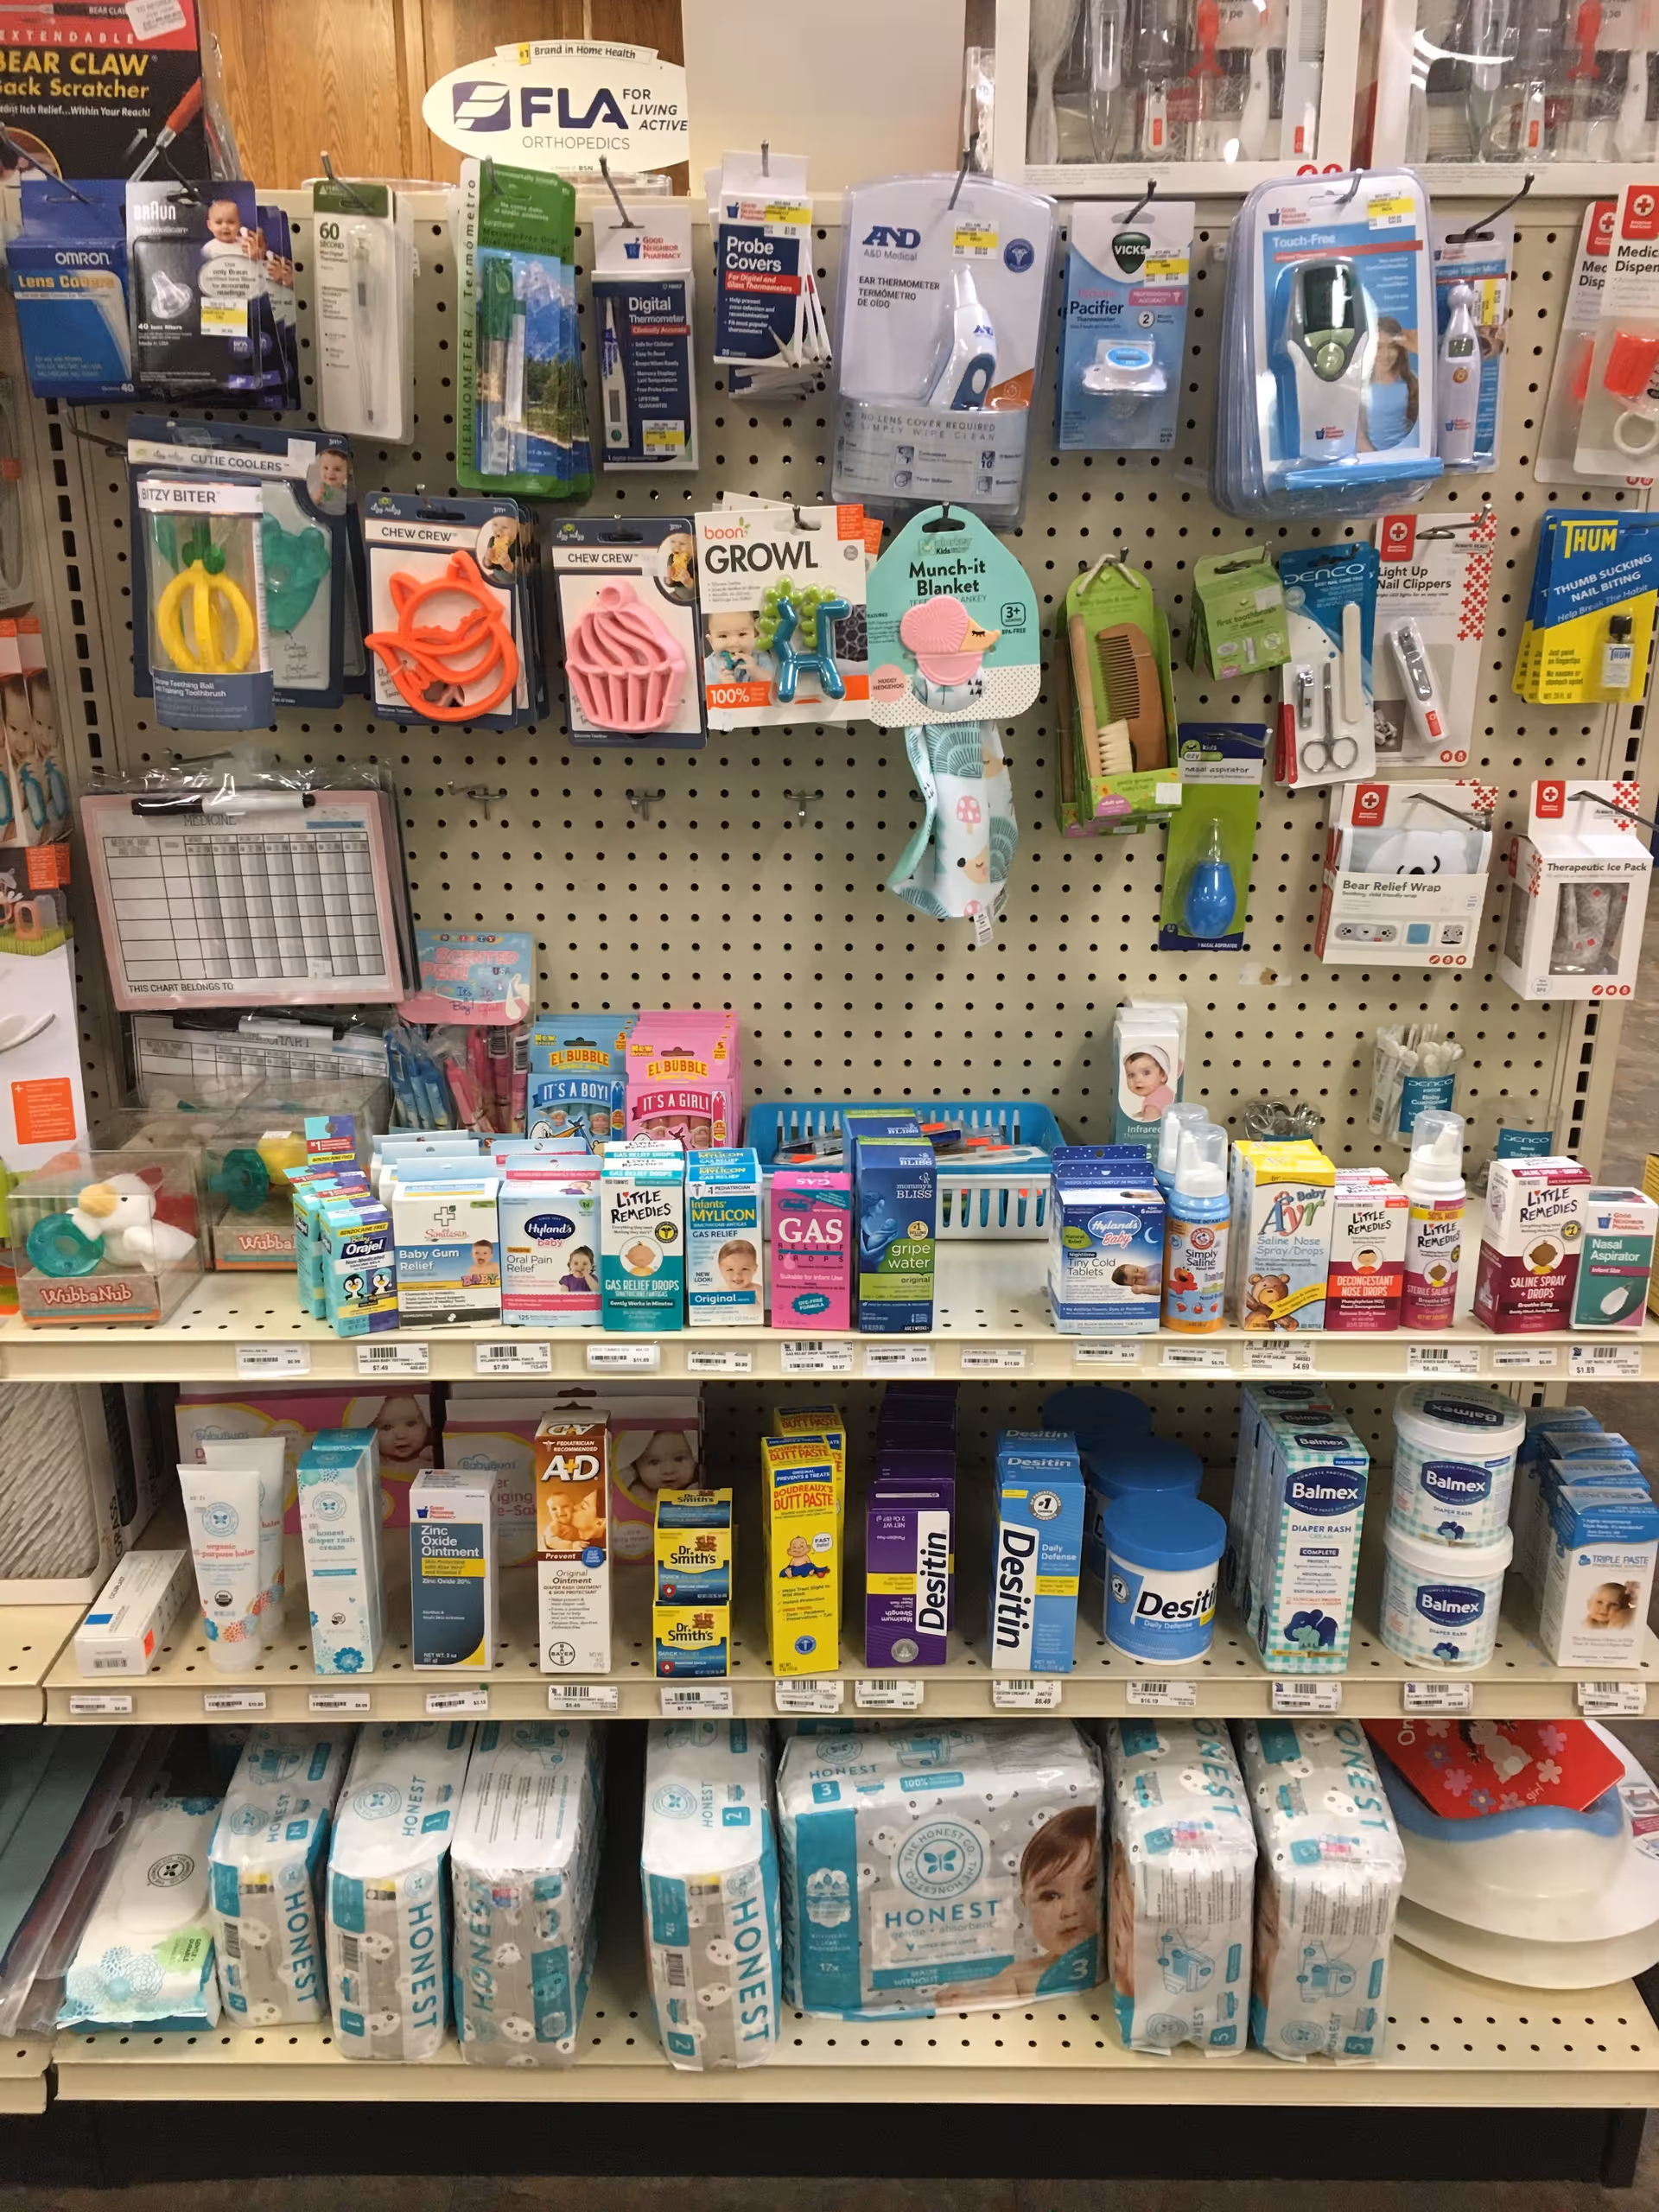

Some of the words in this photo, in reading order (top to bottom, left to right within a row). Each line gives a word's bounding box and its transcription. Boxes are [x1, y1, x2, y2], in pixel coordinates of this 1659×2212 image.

[534, 46, 562, 56] Brand
[575, 46, 602, 55] Home
[605, 48, 636, 59] Health
[70, 53, 149, 76] CLAW
[0, 76, 41, 96] ack
[50, 78, 149, 99] Scratcher
[623, 89, 651, 100] FOR
[521, 87, 629, 129] FLA
[632, 104, 677, 116] LIVING
[639, 120, 688, 131] ACTIVE
[523, 136, 630, 149] ORTHOPEDICS
[320, 223, 340, 239] 60
[727, 236, 773, 254] Probe
[1273, 234, 1336, 248] Touch-Free
[1115, 245, 1147, 255] VICKS
[55, 252, 110, 265] OMRON
[726, 253, 781, 272] Covers
[18, 276, 54, 288] Lens
[60, 276, 115, 289] Covers
[878, 277, 940, 289] THERMOMETER
[629, 297, 671, 314] Digital
[1070, 301, 1123, 315] Pacifier
[190, 454, 222, 466] CUTIE
[226, 457, 283, 472] COOLERS
[142, 489, 170, 502] BITZY
[174, 490, 216, 504] BITER
[382, 526, 415, 537] CHEW
[418, 529, 453, 541] CREW
[705, 526, 744, 539] boon
[1560, 520, 1618, 558] THUM
[568, 553, 599, 563] CHEW
[602, 553, 633, 563] CREW
[705, 541, 818, 574] GROWL
[909, 558, 986, 578] Munch-it
[1378, 567, 1407, 578] Light
[1411, 567, 1427, 578] Up
[1554, 575, 1598, 595] THUMB
[1599, 554, 1653, 579] SUCKING
[918, 578, 979, 596] Blanket
[1377, 580, 1400, 590] Nail
[1403, 579, 1452, 591] Clippers
[1571, 587, 1599, 602] NAIL
[1601, 571, 1642, 592] BITING
[711, 689, 749, 704] 100%
[1548, 863, 1605, 874] Therapeutic
[1607, 863, 1621, 872] Ice
[1624, 863, 1647, 872] Pack
[1343, 880, 1370, 892] Bear
[1374, 882, 1408, 892] Relief
[1411, 883, 1441, 893] Wrap
[129, 984, 148, 993] THIS
[151, 983, 178, 992] CHART
[181, 982, 220, 992] BELONGS
[550, 1054, 563, 1065] EL
[568, 1050, 609, 1066] BUBBLE
[648, 1065, 660, 1076] EL
[664, 1059, 708, 1077] BUBBLE
[896, 1189, 932, 1199] BLISS
[611, 1203, 672, 1224] REMEDIES
[692, 1210, 755, 1222] MYLICON
[1520, 1200, 1578, 1222] REMEDIES
[527, 1223, 572, 1236] Hyland's
[779, 1217, 843, 1243] GAS
[1092, 1217, 1138, 1233] Hyland's
[537, 1238, 563, 1248] baby
[1103, 1232, 1132, 1248] Baby
[1257, 1236, 1288, 1245] Saline
[1592, 1239, 1623, 1249] Nasal
[346, 1240, 383, 1255] Orajel
[892, 1244, 931, 1255] gripe
[1185, 1249, 1217, 1259] Simply
[1256, 1246, 1324, 1256] Spray/Drops
[399, 1250, 428, 1262] Baby
[433, 1249, 460, 1258] Gum
[507, 1255, 528, 1264] Oral
[531, 1255, 552, 1264] Pain
[1186, 1257, 1215, 1266] Saline
[1591, 1250, 1640, 1262] Aspirator
[400, 1262, 434, 1271] Relief
[507, 1264, 535, 1273] Relief
[888, 1259, 930, 1268] water
[1069, 1259, 1089, 1268] Tiny
[1092, 1258, 1116, 1267] Cold
[1067, 1268, 1103, 1276] Tablets
[606, 1280, 621, 1290] GAS
[623, 1280, 650, 1290] RELIEF
[652, 1280, 679, 1290] DROPS
[1338, 1275, 1393, 1286] DECONGESTANT
[1510, 1276, 1538, 1287] SALINE
[1541, 1275, 1566, 1286] SPRAY
[40, 1283, 132, 1306] WubbaNub
[1342, 1287, 1360, 1296] NOSE
[1363, 1287, 1387, 1296] DROPS
[695, 1294, 736, 1305] Original
[1293, 1362, 1310, 1370] $4.69
[541, 1455, 600, 1481] A+D
[1426, 1471, 1486, 1493] Balmex
[1293, 1483, 1358, 1499] Balmex
[774, 1494, 801, 1510] BUTT
[804, 1493, 834, 1507] PASTE
[421, 1525, 448, 1535] Zinc
[421, 1535, 457, 1547] Oxide
[421, 1546, 479, 1557] Ointment
[1041, 1552, 1077, 1561] Defense
[671, 1552, 715, 1565] Smith's
[1593, 1555, 1619, 1565] TRIPLE
[1623, 1555, 1649, 1566] PASTE
[918, 1530, 948, 1630] Desitin
[997, 1530, 1035, 1649] Desitin
[1421, 1594, 1479, 1614] Balmex
[668, 1629, 714, 1642] Smith's
[886, 1900, 998, 1929] HONEST
[284, 1890, 318, 2002] HONEST
[409, 1900, 437, 2029] HONEST
[731, 1897, 769, 2043] HONEST
[893, 1975, 938, 1986] WITHOUT
